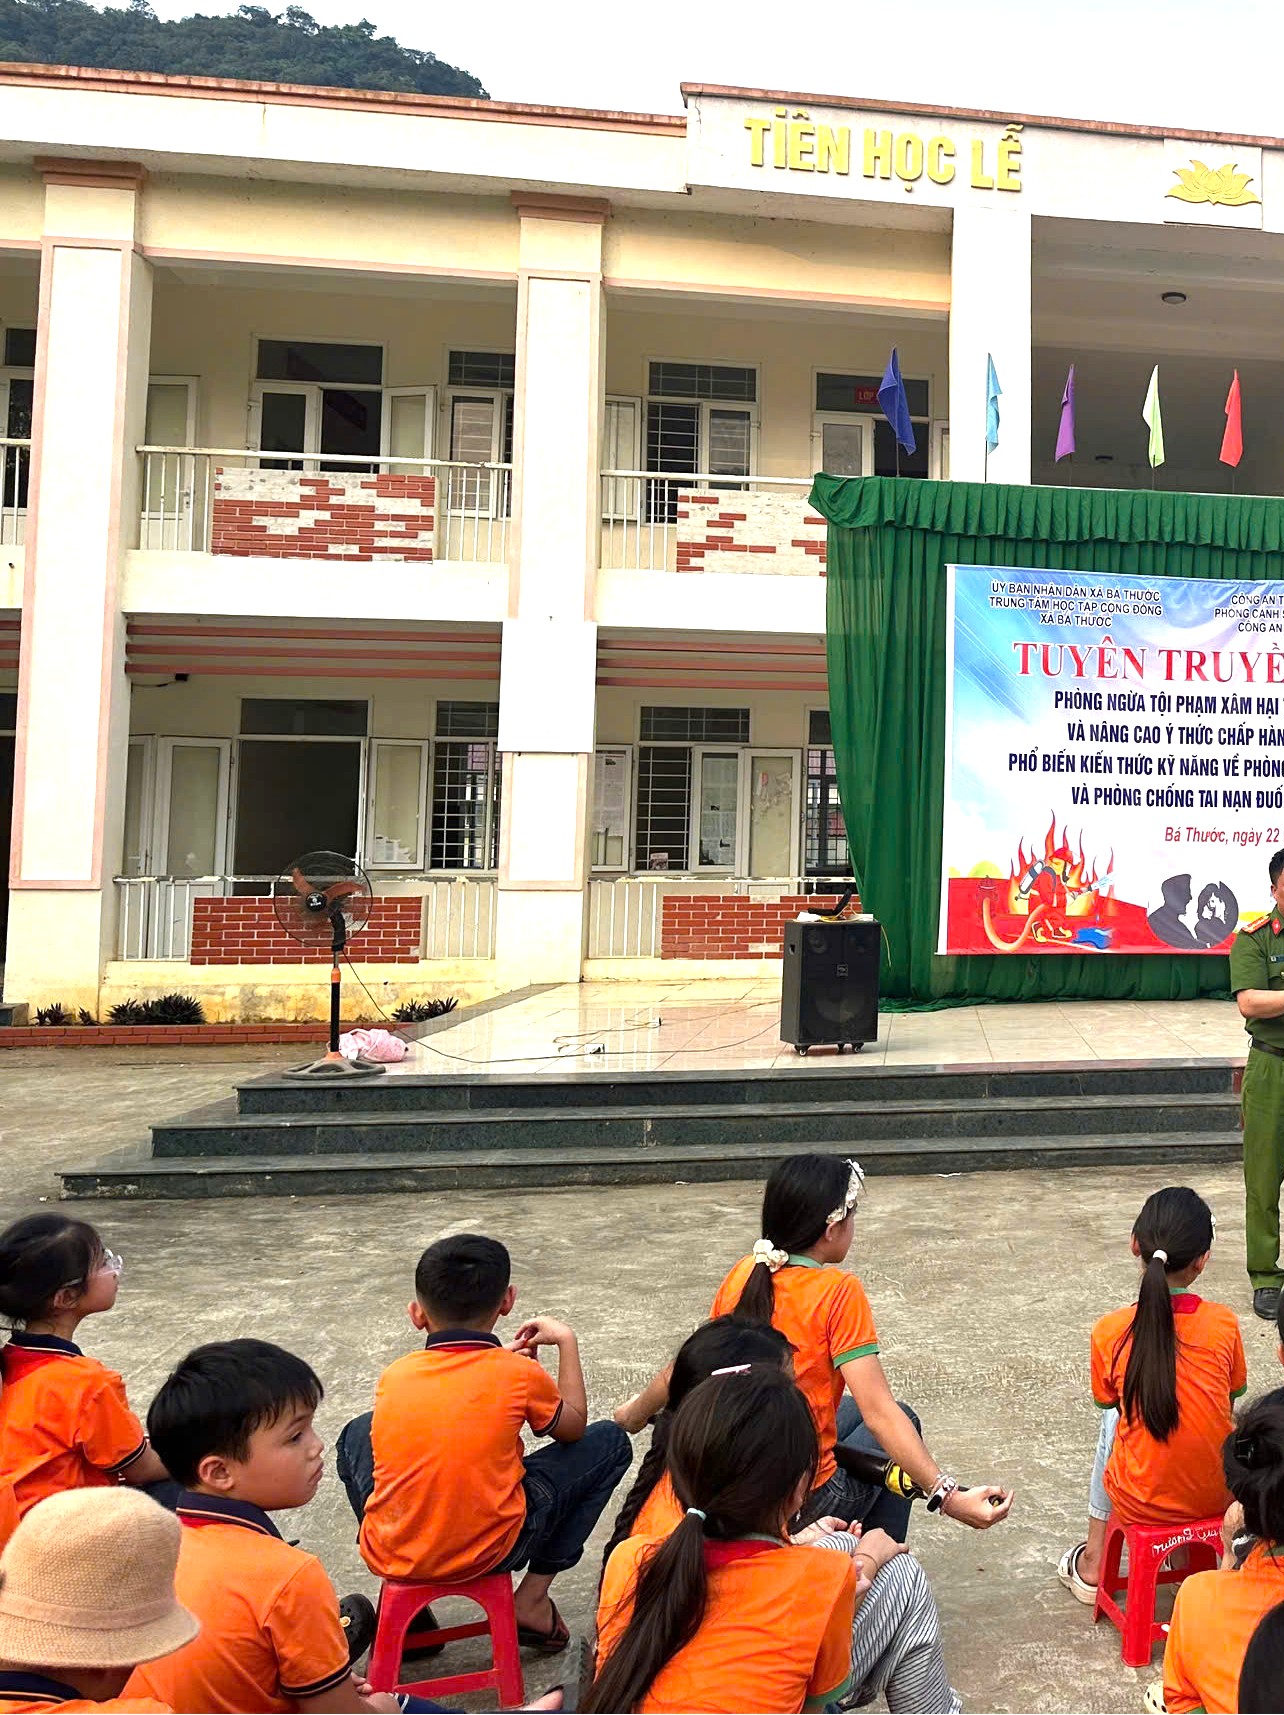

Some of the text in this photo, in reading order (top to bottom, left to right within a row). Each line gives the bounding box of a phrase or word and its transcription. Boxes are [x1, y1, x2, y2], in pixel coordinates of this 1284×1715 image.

[863, 128, 956, 192] HỌC
[971, 123, 1024, 192] LỄ
[1013, 635, 1147, 680] TUYÊN
[1054, 687, 1103, 711] PHÒNG
[1107, 689, 1146, 712] NGỪA
[1150, 692, 1172, 716] TỘI
[1176, 695, 1217, 718] PHẠM
[1220, 693, 1252, 715] XÂM
[1256, 697, 1279, 719] HẠI
[1067, 719, 1086, 741] VÀ
[1090, 720, 1129, 744] NÂNG
[1133, 725, 1161, 744] CAO
[1166, 722, 1174, 744] Ý
[1178, 724, 1214, 745] THỨC
[1218, 721, 1254, 746] CHẤP
[1008, 746, 1038, 772] PHỔ
[1042, 749, 1076, 773] BIẾN
[1080, 750, 1113, 774] KIẾN
[1117, 752, 1153, 775] THỨC
[1157, 754, 1175, 776] KỸ
[1179, 754, 1219, 777] NĂNG
[1222, 753, 1240, 777] VỀ
[1071, 782, 1090, 805] VÀ
[1094, 784, 1142, 807] PHÒNG
[1145, 782, 1194, 808] CHỐNG
[1198, 789, 1218, 808] TAI
[1222, 790, 1251, 812] NẠN
[1165, 826, 1181, 842] Bá
[1185, 827, 1229, 845] Thước,
[1232, 828, 1262, 846] ngày
[1265, 828, 1280, 843] 22
